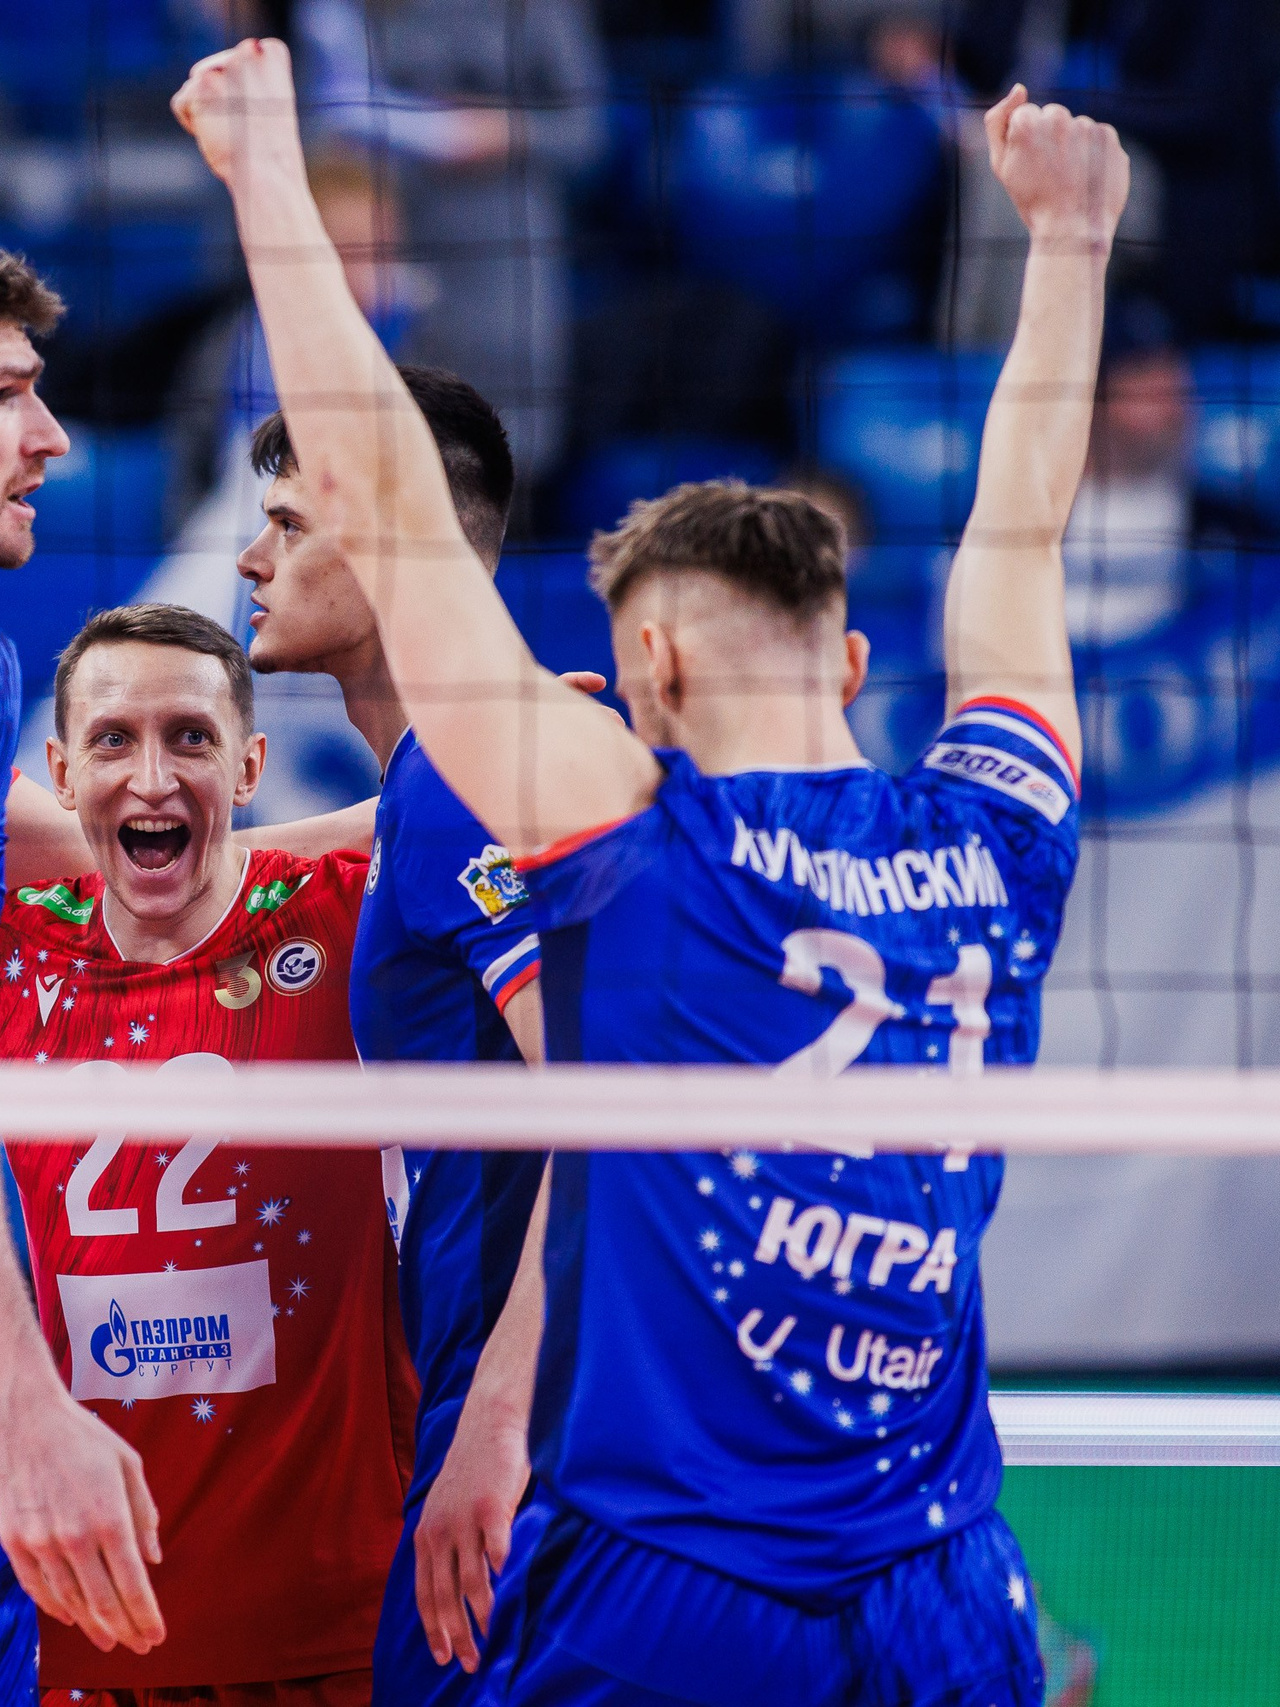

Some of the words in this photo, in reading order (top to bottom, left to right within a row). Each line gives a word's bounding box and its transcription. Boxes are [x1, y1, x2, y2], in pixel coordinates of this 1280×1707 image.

[775, 928, 992, 1172] 21
[65, 1052, 237, 1236] 22
[753, 1196, 958, 1294] ЮГРА
[130, 1313, 230, 1346] ГАЗПРОМ
[138, 1345, 230, 1361] ТРАНСГАЗ
[826, 1323, 944, 1391] Utair
[137, 1358, 233, 1377] СУРГУТ
